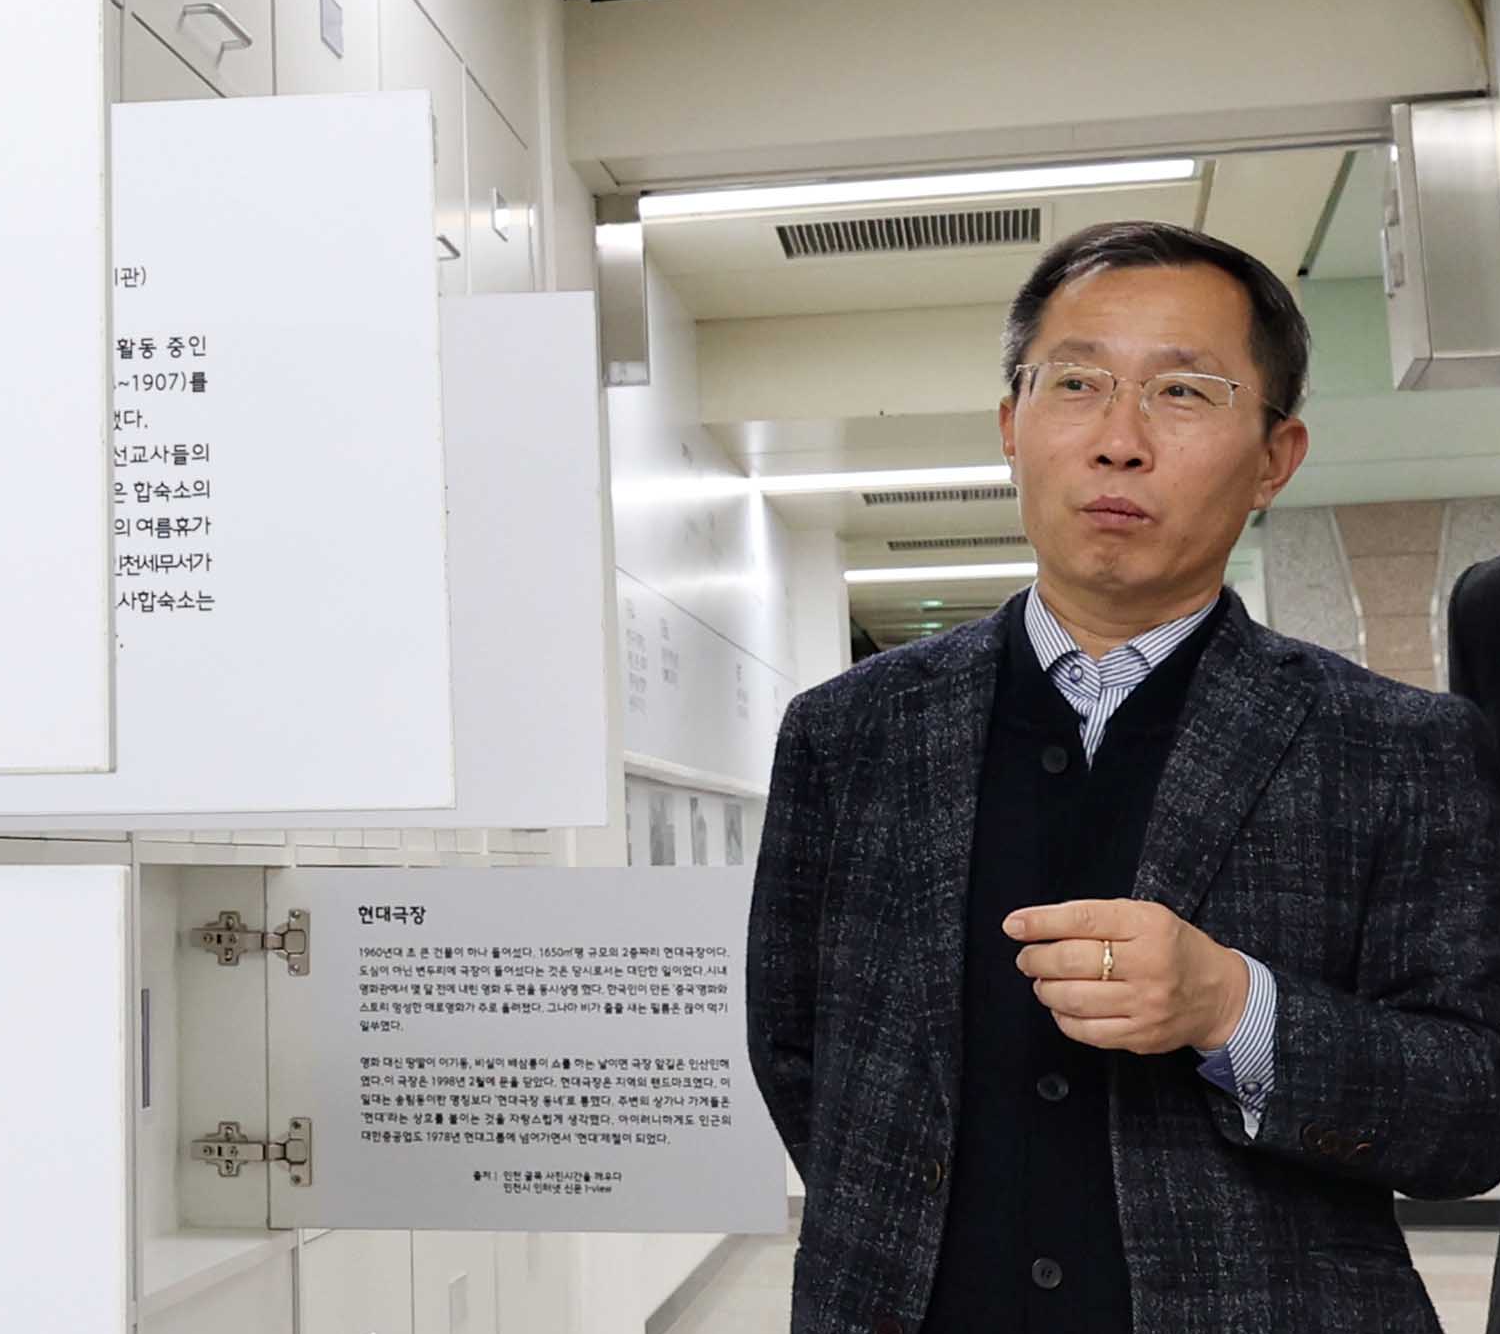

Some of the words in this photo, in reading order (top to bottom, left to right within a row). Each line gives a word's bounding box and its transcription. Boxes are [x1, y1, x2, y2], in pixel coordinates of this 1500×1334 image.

[116, 337, 157, 360] 활동
[167, 335, 207, 359] 중인
[134, 479, 211, 503] 합숙소의
[136, 516, 211, 539] 여름휴가
[357, 904, 427, 926] 현대극장
